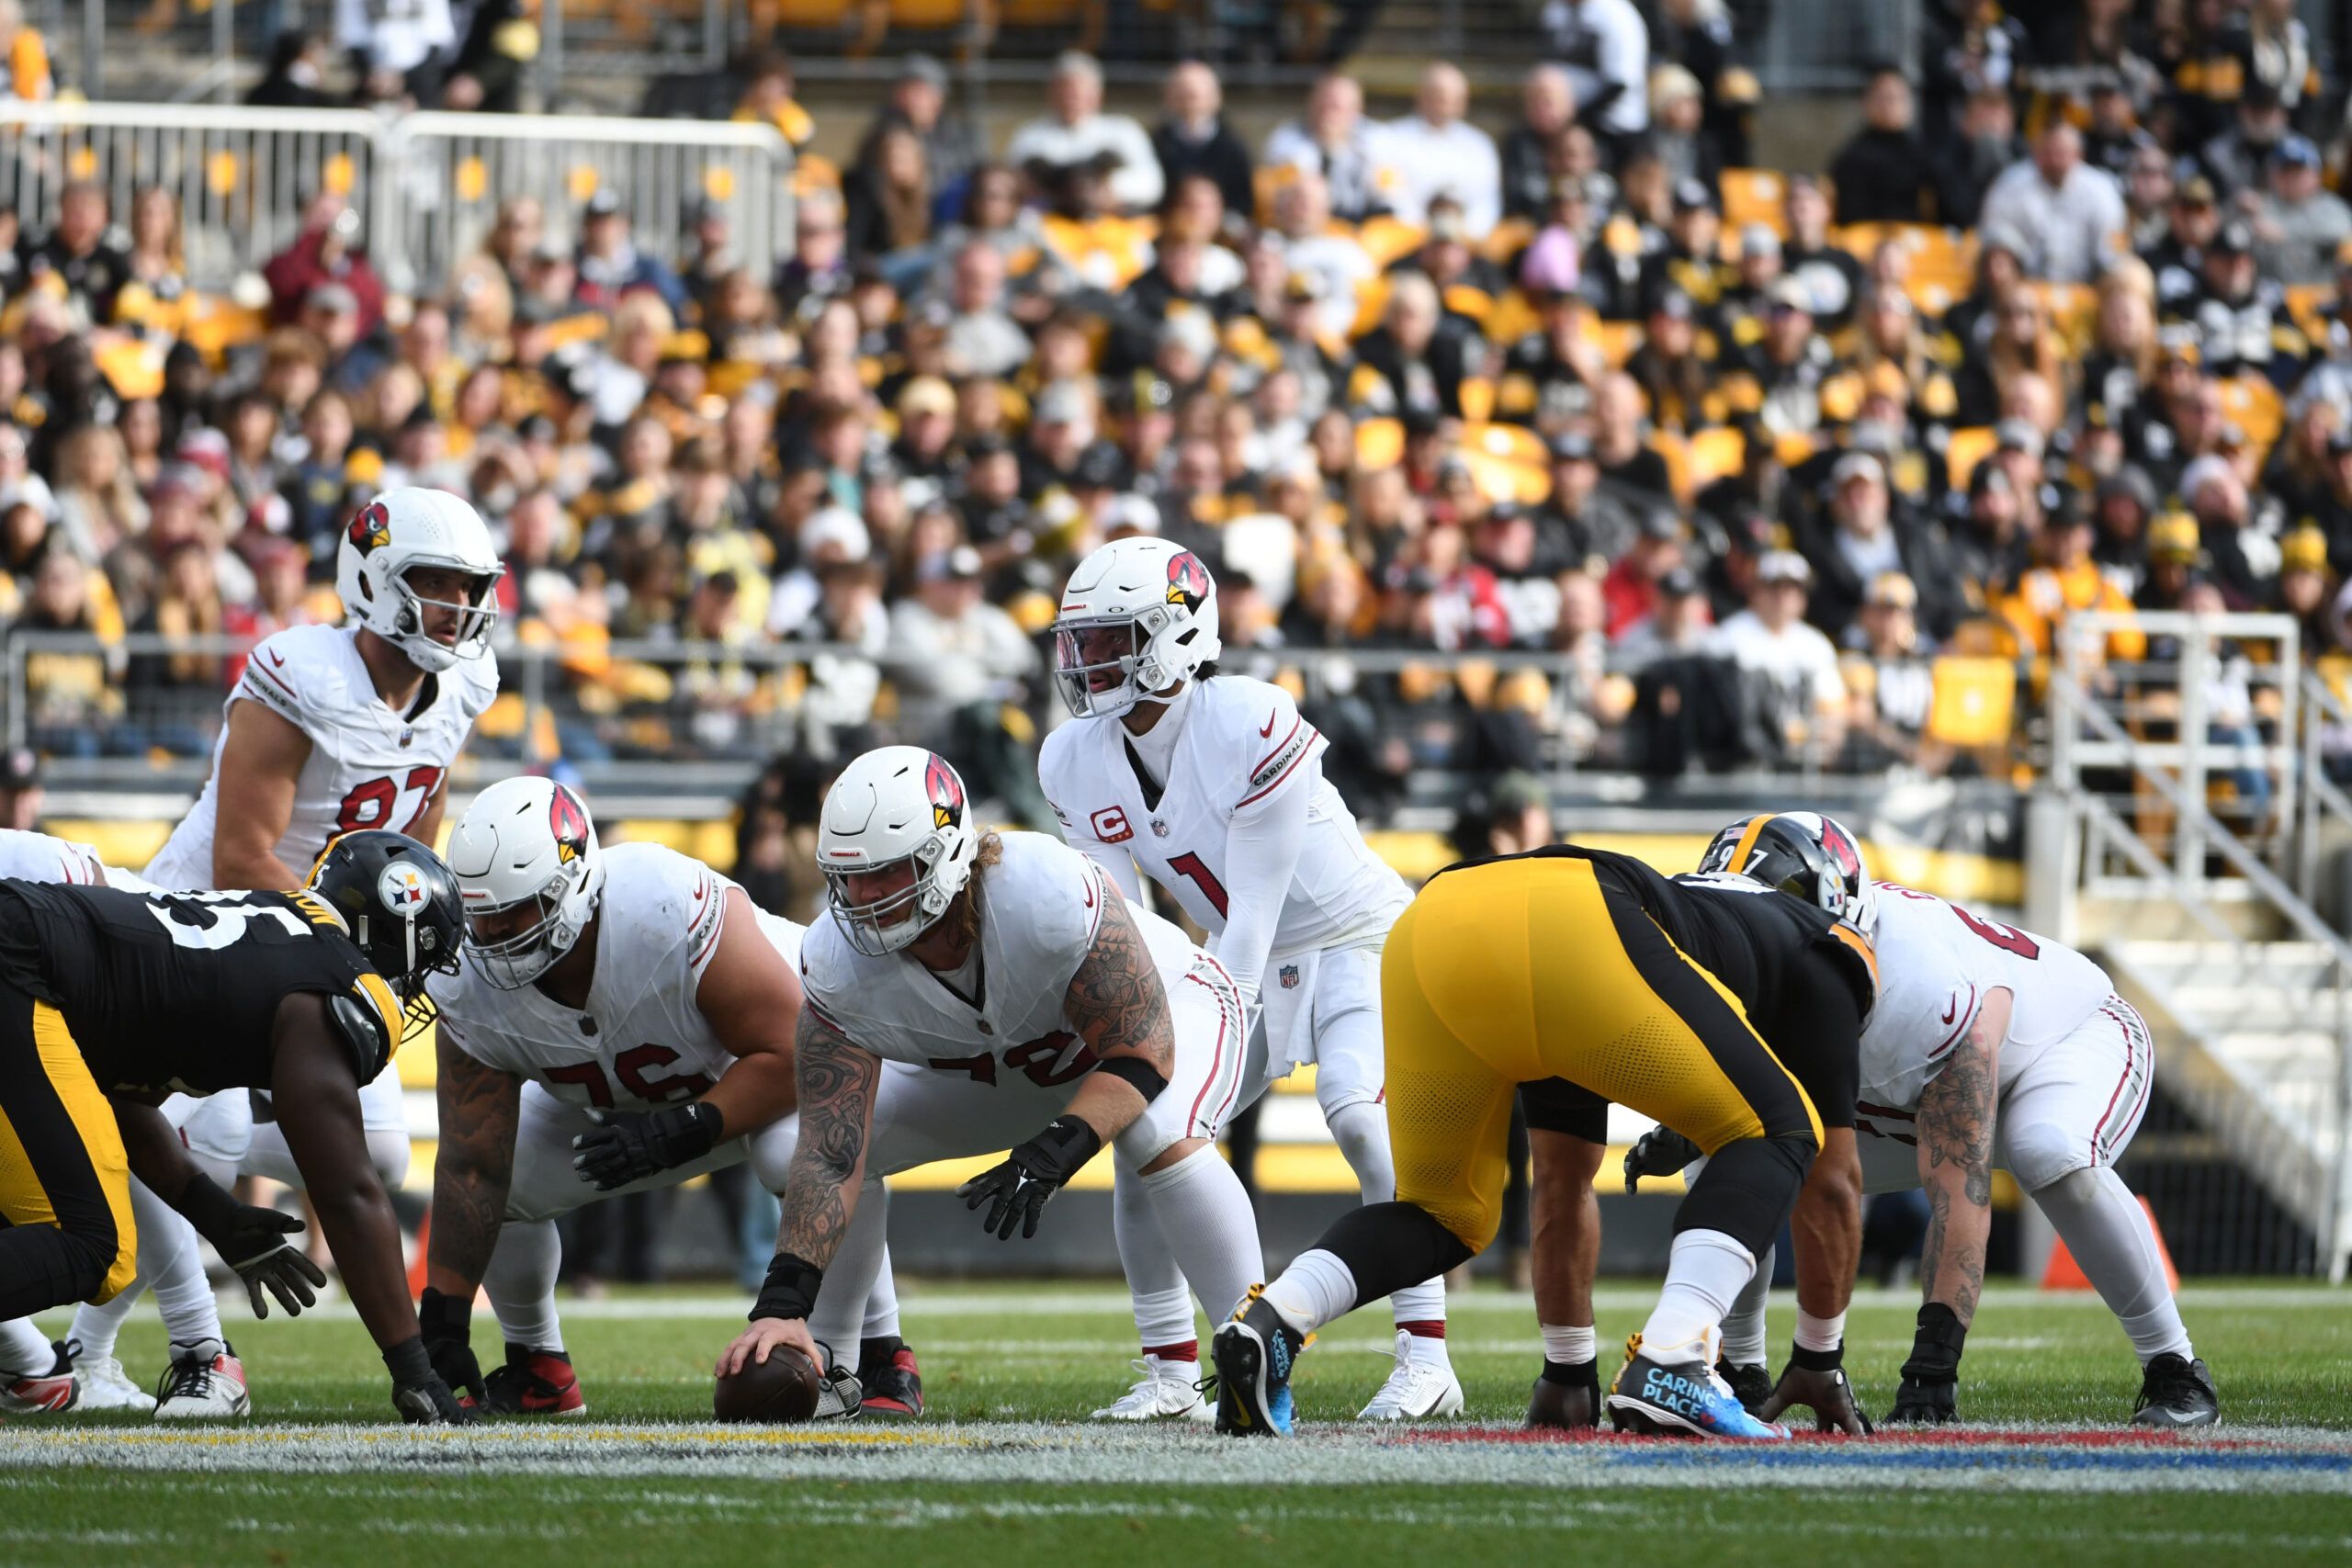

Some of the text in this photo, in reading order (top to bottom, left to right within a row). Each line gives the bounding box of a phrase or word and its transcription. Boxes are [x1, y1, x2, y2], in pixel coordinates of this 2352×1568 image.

[1253, 737, 1304, 786] CARDINALS
[1094, 808, 1126, 838] C
[1716, 845, 1770, 875] 97
[1166, 851, 1229, 921] 1
[541, 1043, 716, 1110] 76
[1643, 1383, 1702, 1420] PLACE
[1646, 1368, 1716, 1408] CARING
